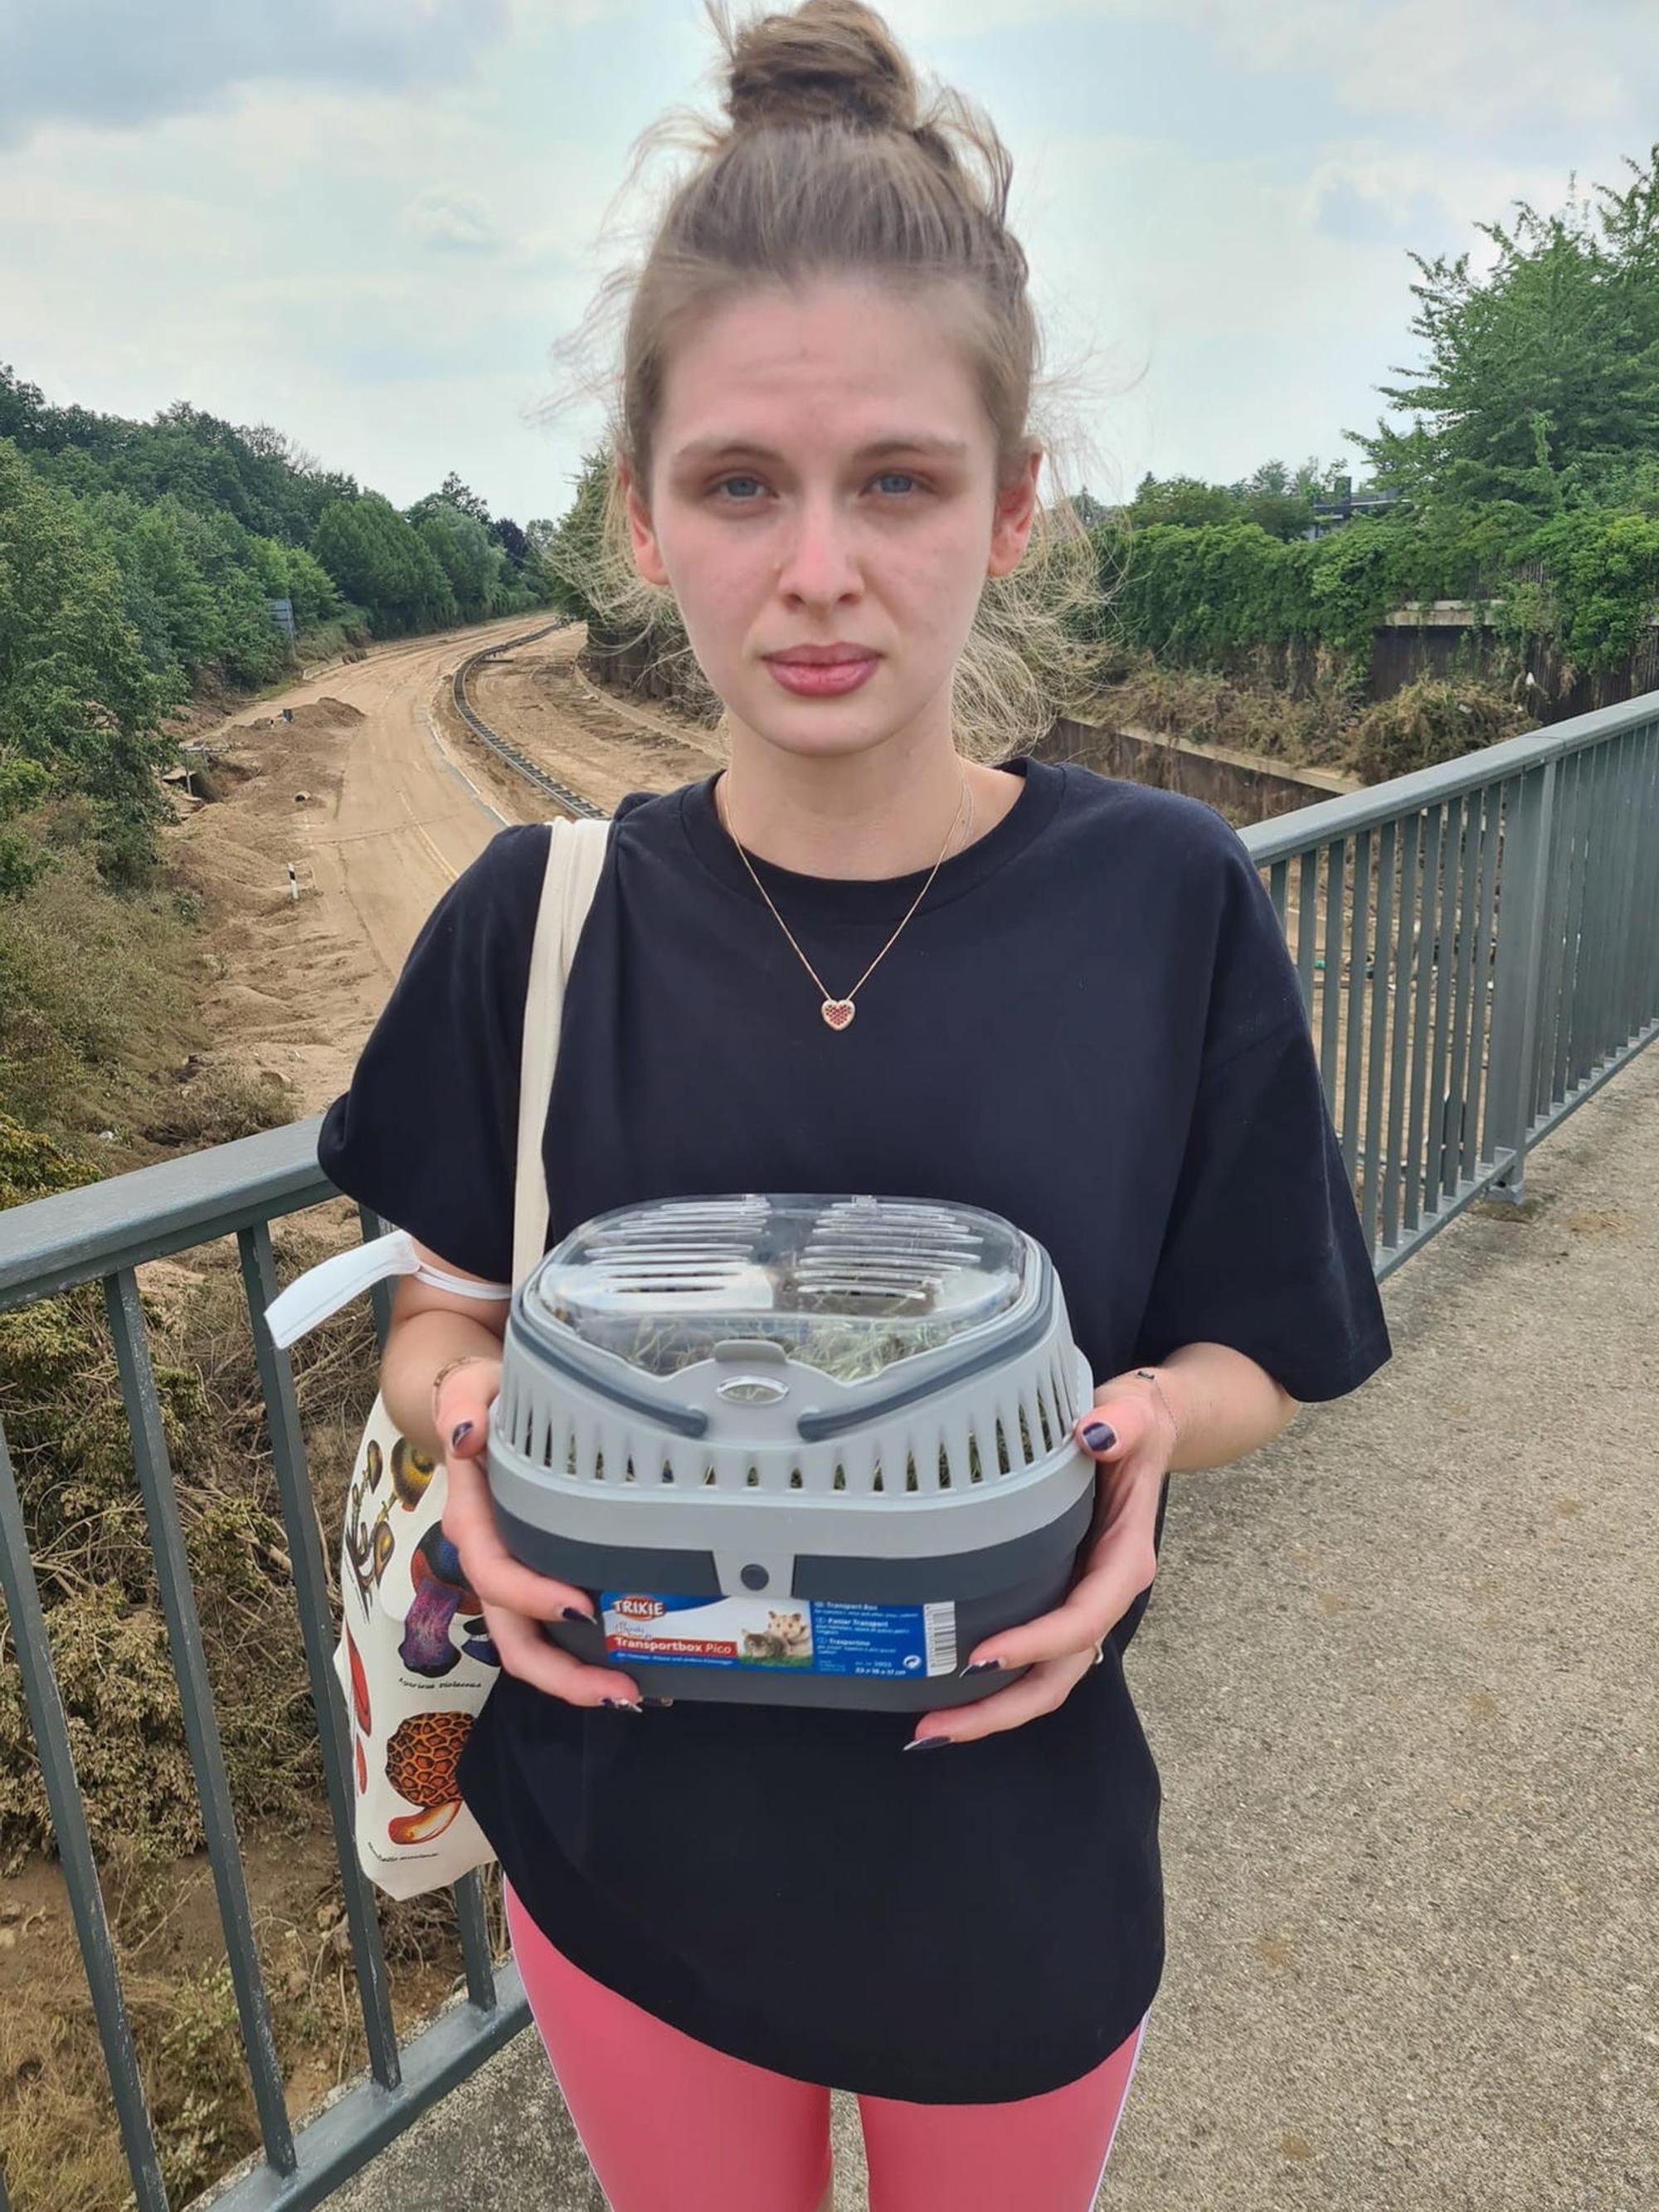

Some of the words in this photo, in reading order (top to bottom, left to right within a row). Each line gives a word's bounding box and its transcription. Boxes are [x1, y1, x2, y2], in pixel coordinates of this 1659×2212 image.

[612, 1599, 664, 1616] TRIXIE
[614, 1637, 703, 1653] Transportbox
[705, 1644, 732, 1654] Pico
